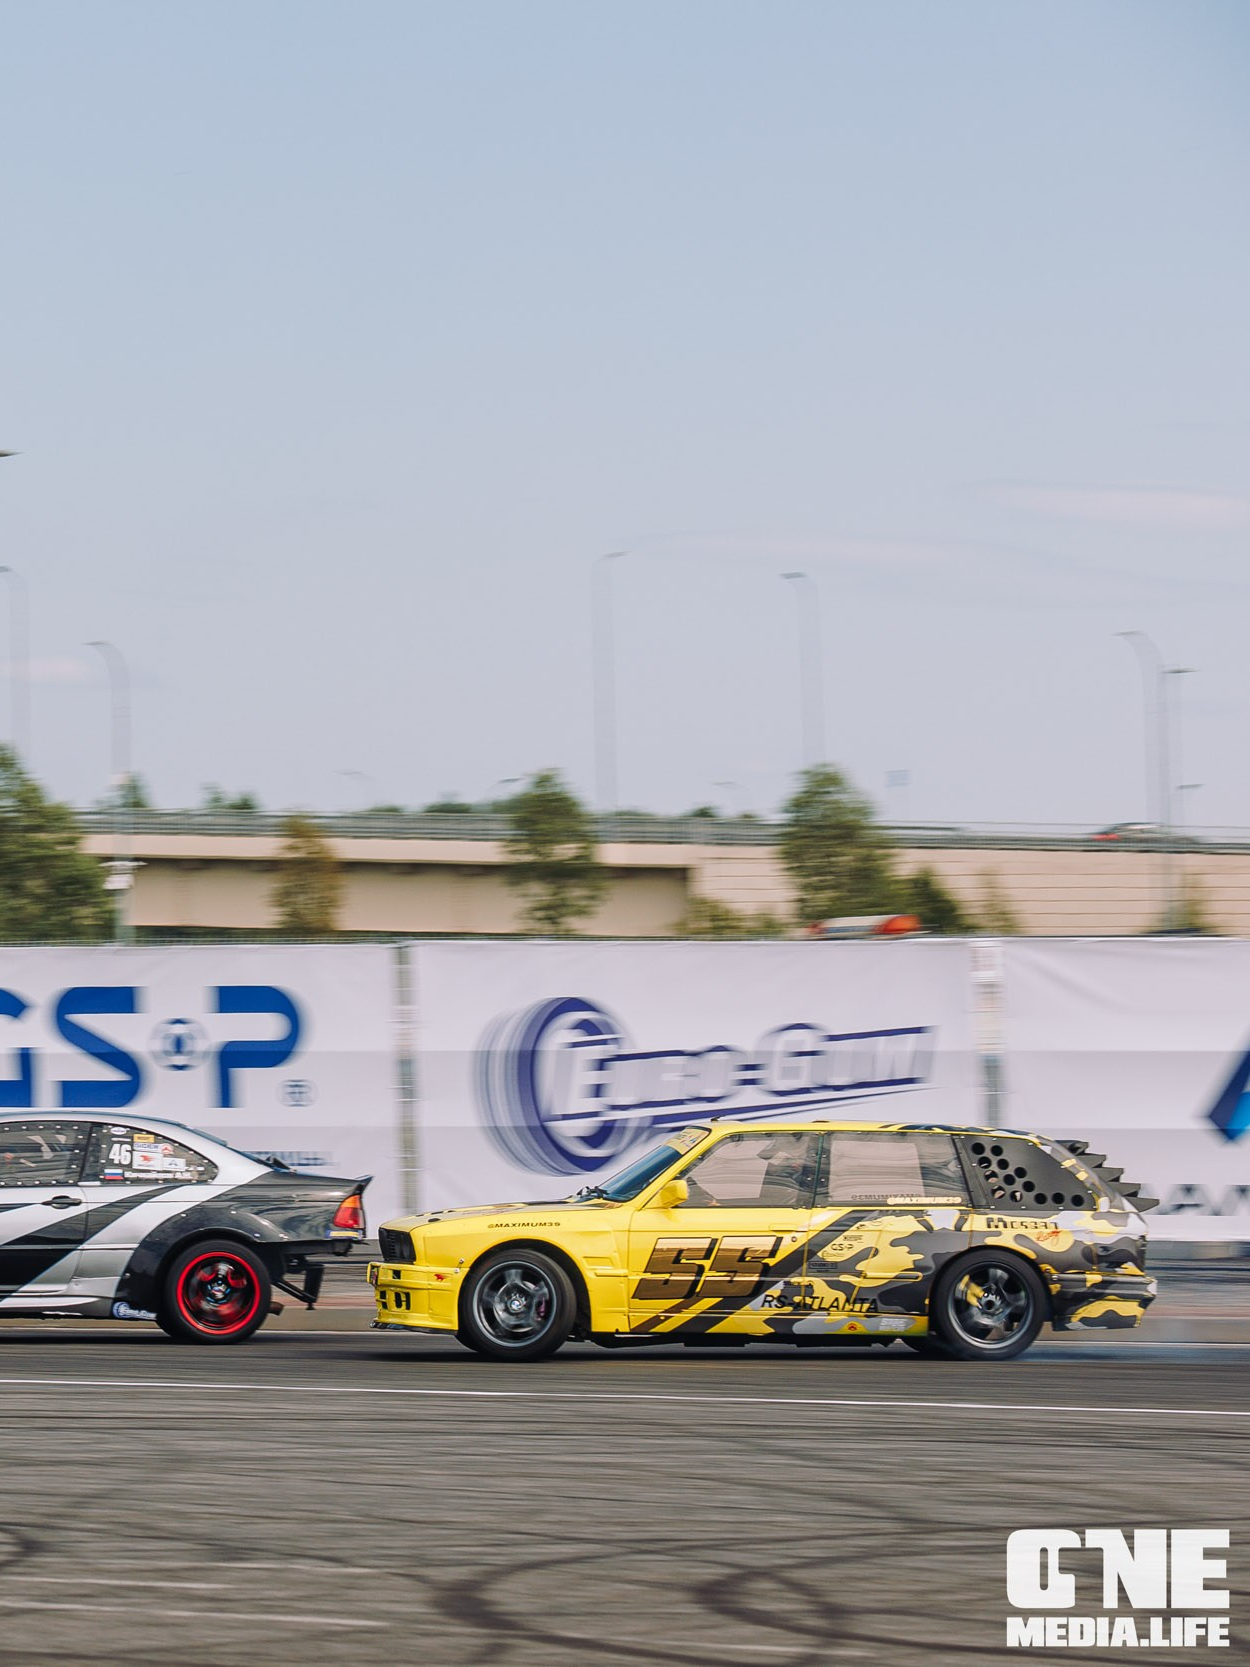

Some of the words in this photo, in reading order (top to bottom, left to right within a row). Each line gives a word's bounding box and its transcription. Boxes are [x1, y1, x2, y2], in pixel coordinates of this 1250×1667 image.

[109, 1143, 132, 1165] 46
[631, 1235, 784, 1300] 55
[761, 1293, 880, 1313] RS-ATLANTA
